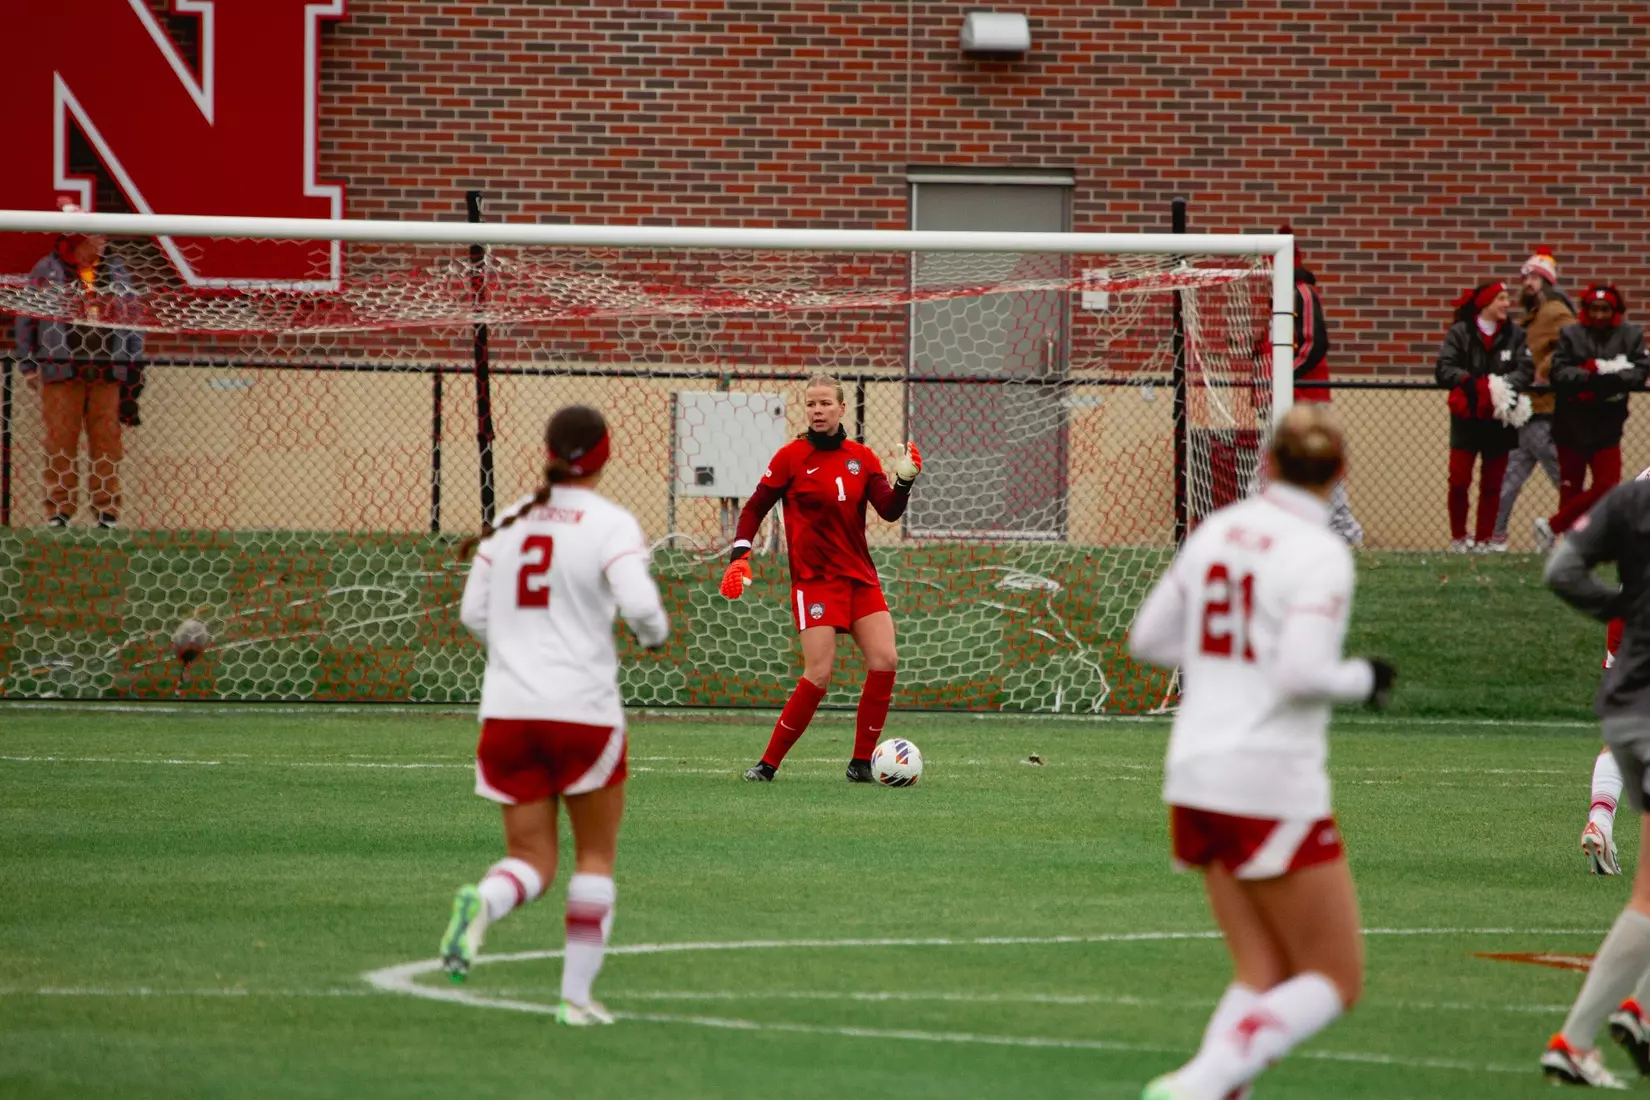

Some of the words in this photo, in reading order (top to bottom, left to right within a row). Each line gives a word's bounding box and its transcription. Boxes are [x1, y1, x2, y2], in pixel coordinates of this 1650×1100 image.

[0, 0, 345, 293] N
[835, 476, 847, 502] 1
[517, 534, 554, 608] 2
[1200, 562, 1256, 662] 21
